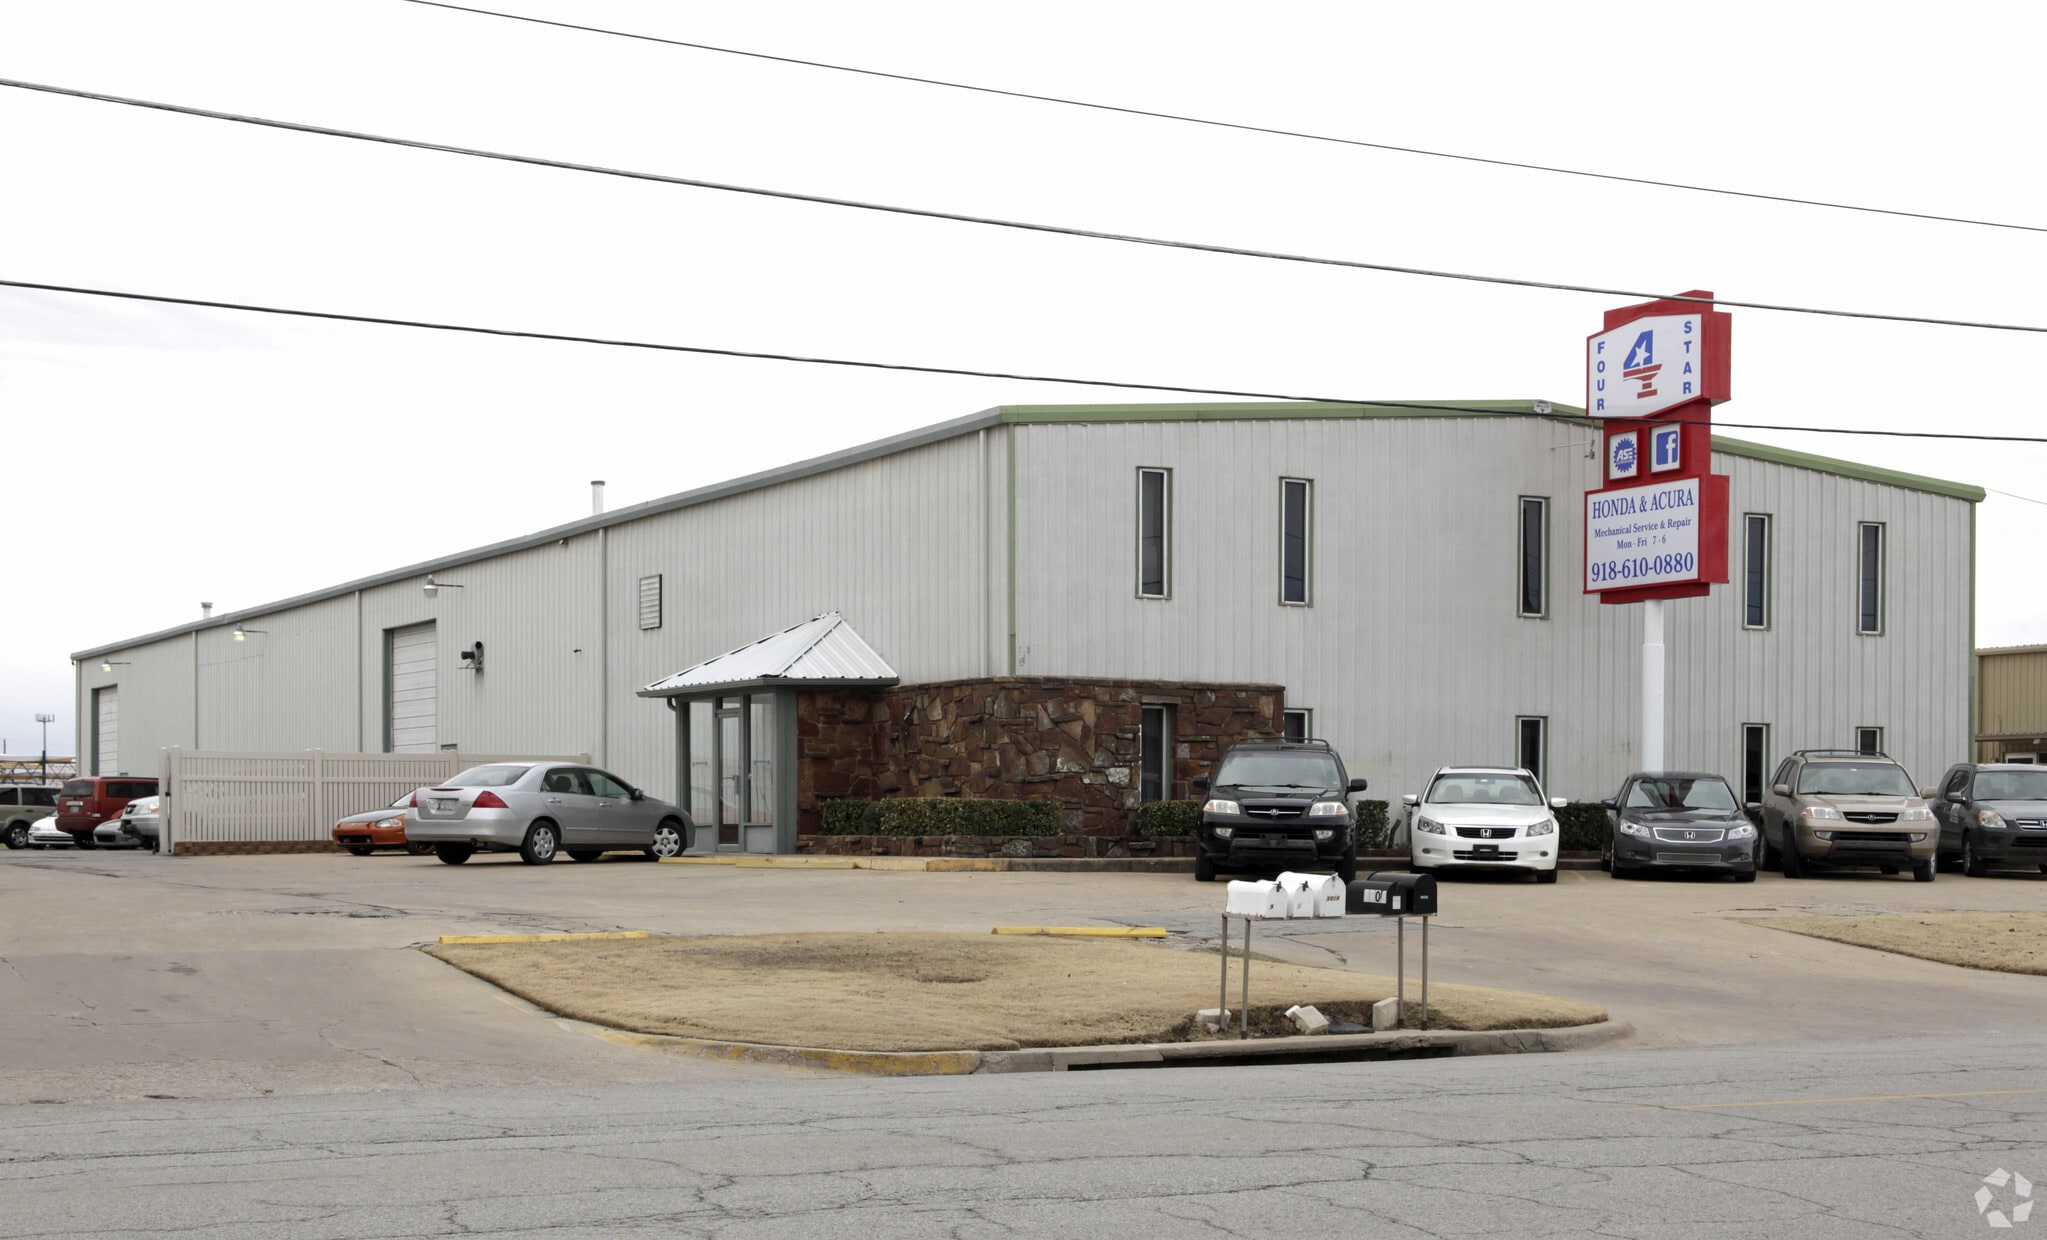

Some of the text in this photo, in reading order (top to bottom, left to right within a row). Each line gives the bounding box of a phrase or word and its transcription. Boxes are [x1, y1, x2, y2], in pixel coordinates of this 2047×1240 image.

[1683, 320, 1693, 394] STAR
[1597, 341, 1606, 411] FOUR
[1616, 447, 1634, 462] ASE
[1592, 487, 1694, 519] HONDA & ACURA
[1594, 517, 1691, 538] Mechanical Service & Repair
[1617, 540, 1632, 550] Mon
[1637, 537, 1647, 547] Fri
[1661, 534, 1666, 543] 6
[1591, 552, 1694, 582] 918-610-0880
